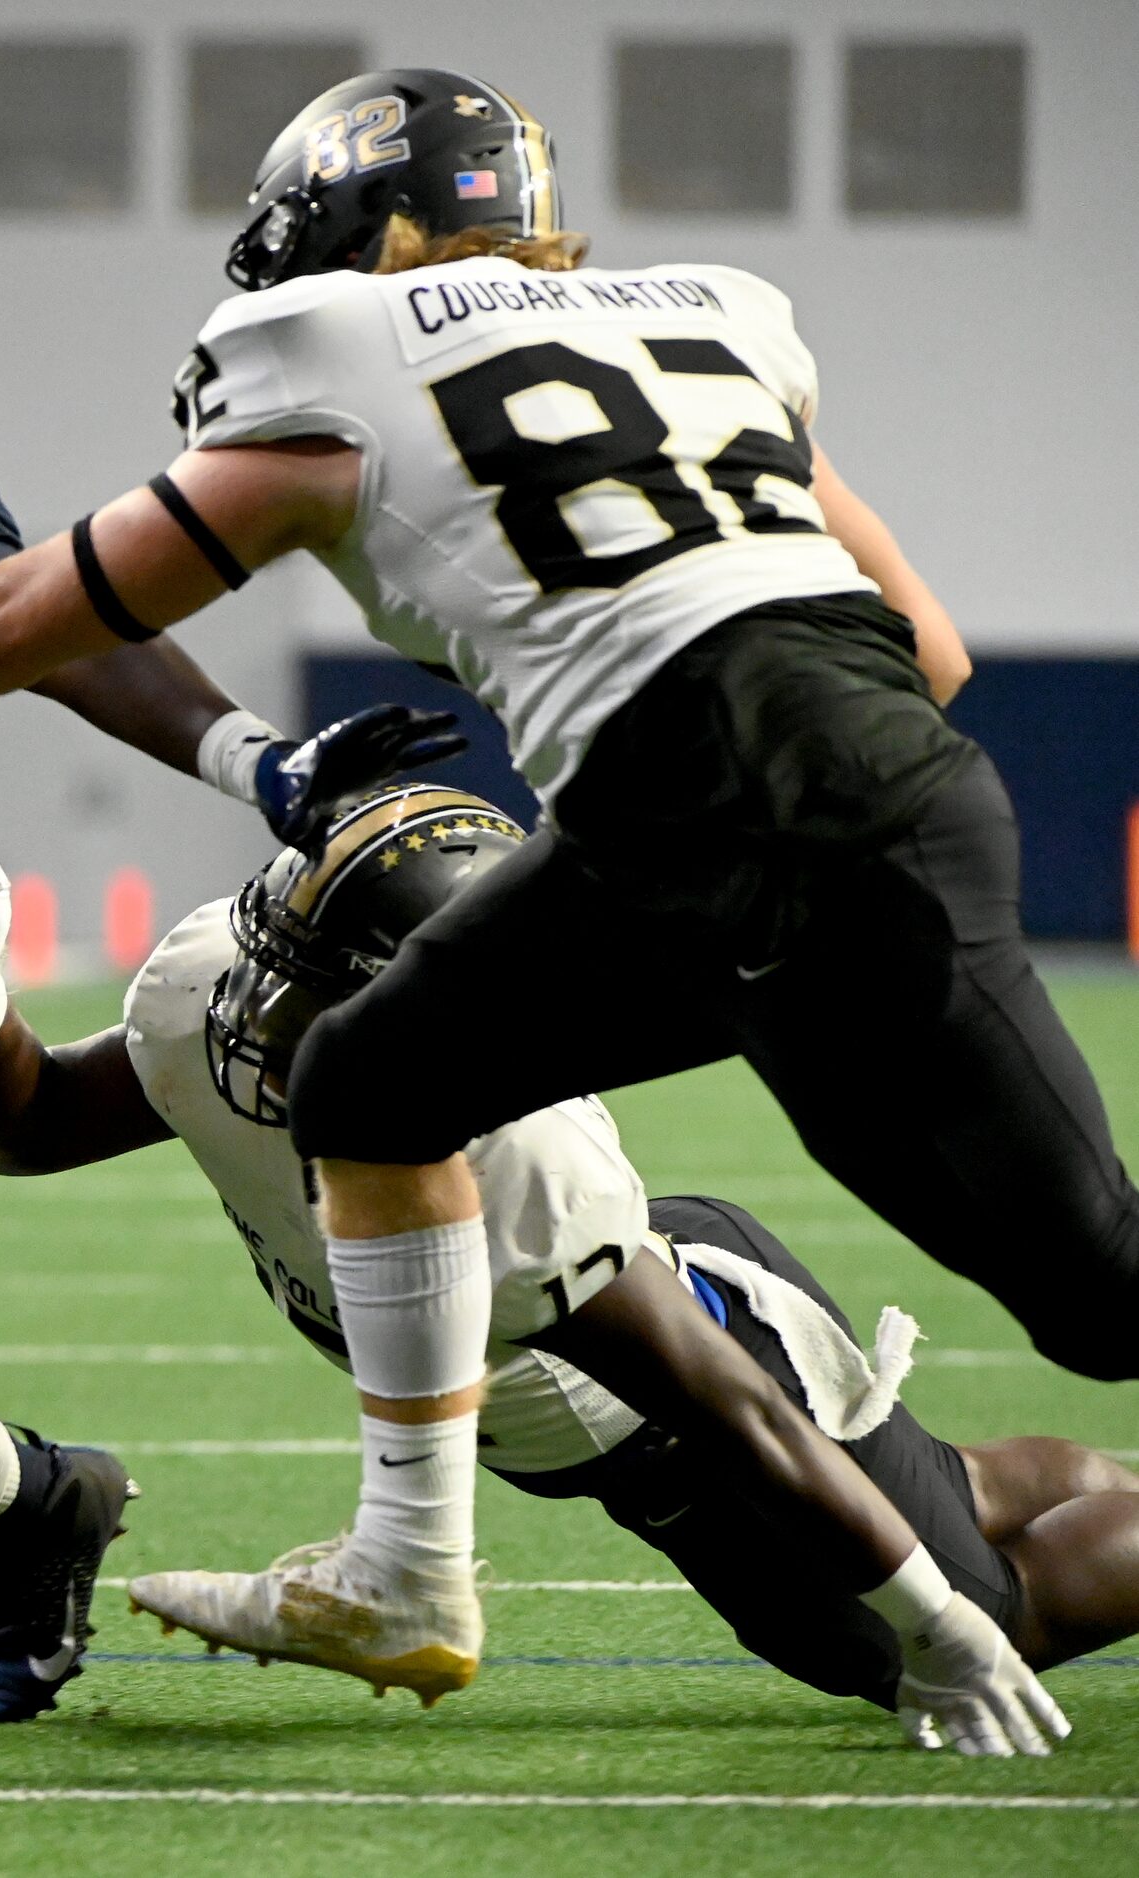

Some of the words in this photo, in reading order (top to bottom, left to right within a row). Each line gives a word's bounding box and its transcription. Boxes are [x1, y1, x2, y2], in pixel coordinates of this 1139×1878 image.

[302, 94, 411, 188] 82
[407, 279, 582, 335] COUGAR
[578, 279, 728, 318] NATION
[427, 337, 827, 595] 82
